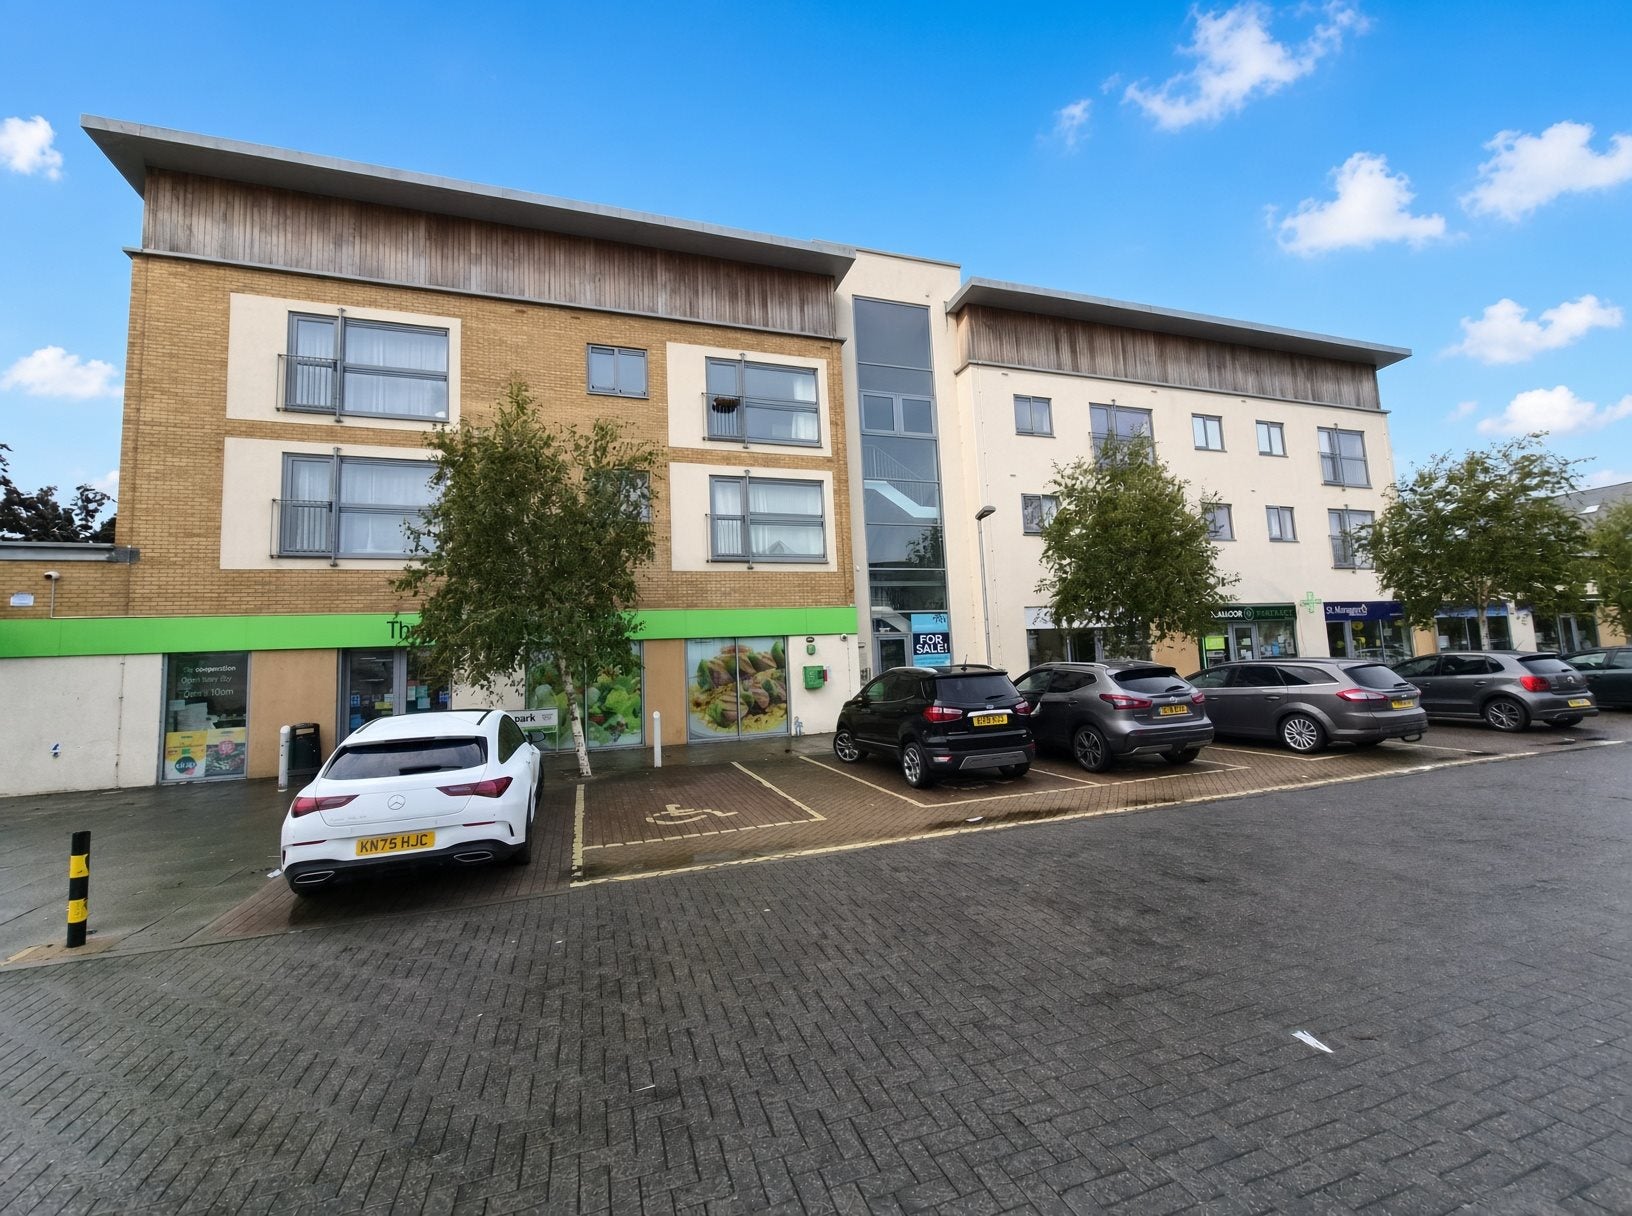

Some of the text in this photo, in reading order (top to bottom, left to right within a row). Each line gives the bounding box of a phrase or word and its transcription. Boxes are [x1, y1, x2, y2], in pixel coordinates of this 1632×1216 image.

[920, 634, 943, 644] FOR
[916, 643, 948, 654] SALE!
[360, 834, 428, 853] KN75 HJC
